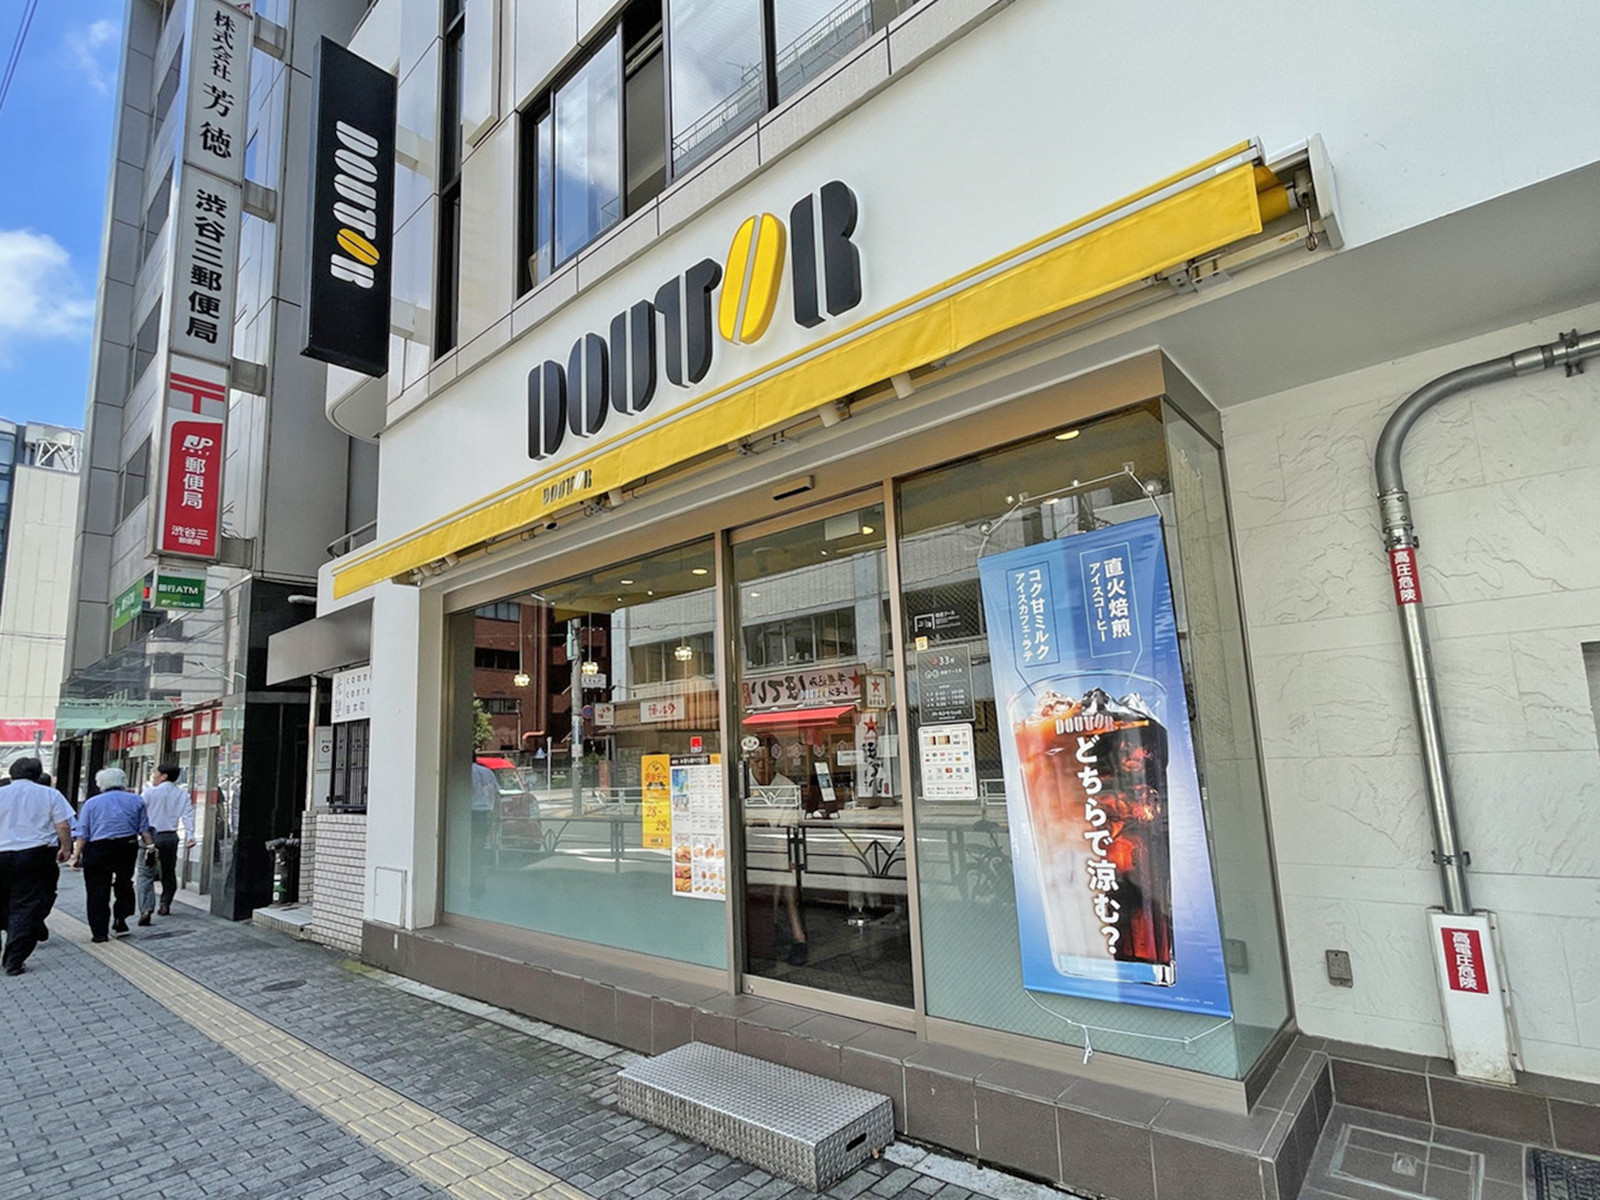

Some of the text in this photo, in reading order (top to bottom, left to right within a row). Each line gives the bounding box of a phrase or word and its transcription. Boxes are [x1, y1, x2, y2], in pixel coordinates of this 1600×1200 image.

[330, 120, 381, 289] DOUTOR
[186, 189, 227, 345] 渋谷三郵便局
[527, 179, 862, 461] DOUTOR
[181, 456, 206, 509] 郵便局
[543, 469, 592, 506] DOUTOR
[171, 525, 208, 540] 渋谷三
[1028, 568, 1050, 660] コク甘ミルク
[1089, 562, 1108, 642] アイスコーヒー
[1103, 557, 1132, 639] 直火焙煎
[1393, 550, 1417, 602] 高圧危険
[1014, 573, 1034, 663] アイスカフェ・ラテ
[1055, 713, 1115, 735] DOUTOR
